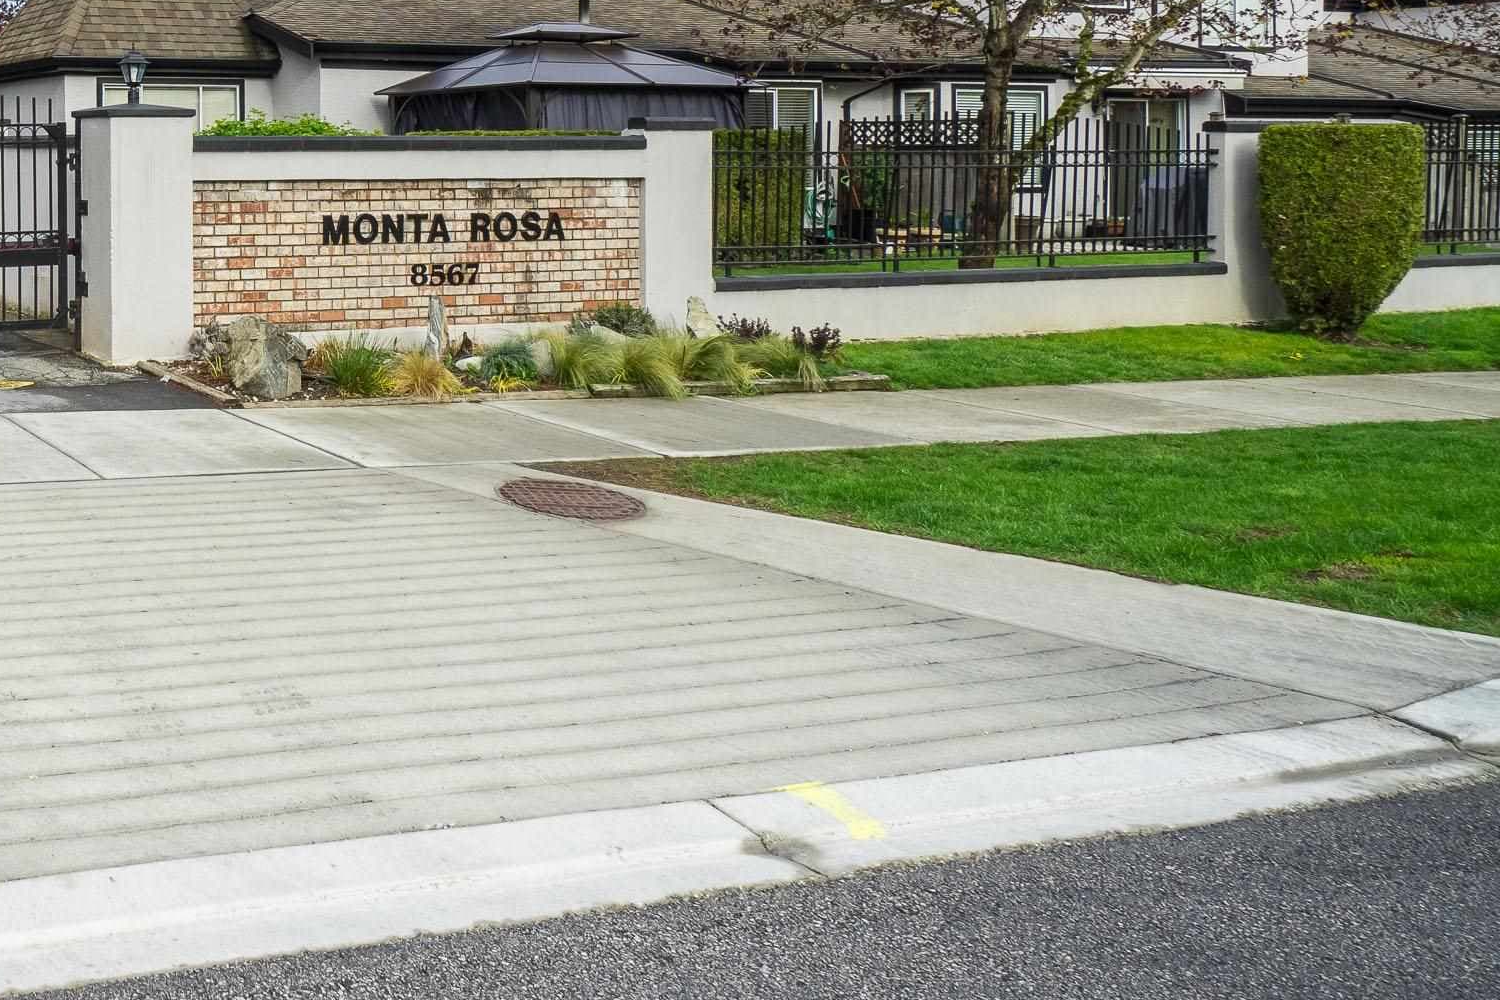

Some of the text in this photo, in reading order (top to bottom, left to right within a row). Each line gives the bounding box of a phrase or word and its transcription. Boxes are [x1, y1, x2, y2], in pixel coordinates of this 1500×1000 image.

[322, 210, 566, 245] MONTA ROSA
[411, 263, 480, 287] 8567
